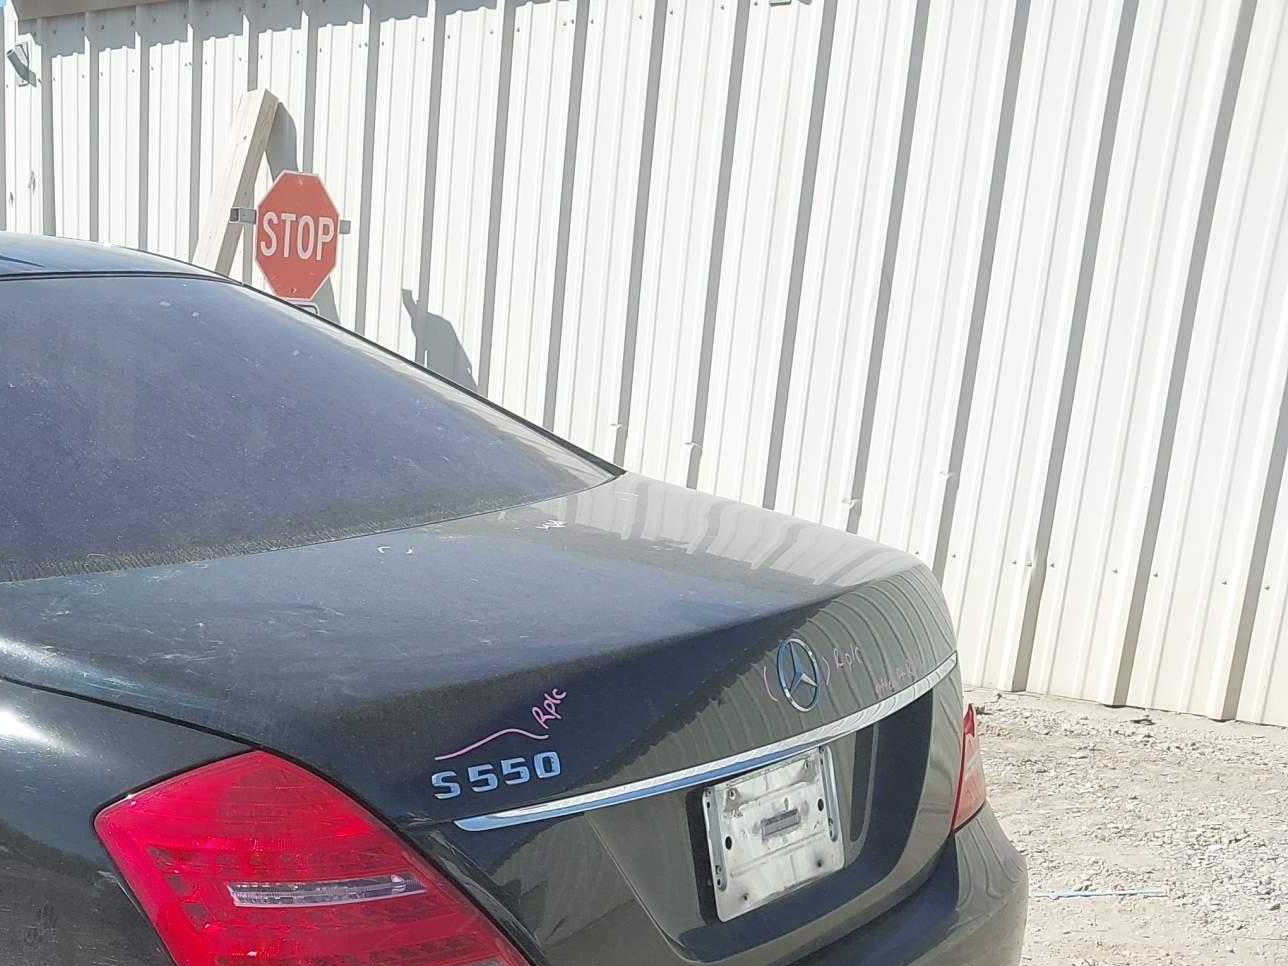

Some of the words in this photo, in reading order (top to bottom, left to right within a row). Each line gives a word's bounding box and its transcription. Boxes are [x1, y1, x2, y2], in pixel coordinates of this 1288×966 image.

[260, 211, 335, 261] STOP
[431, 770, 461, 800] S
[467, 751, 561, 793] 550
